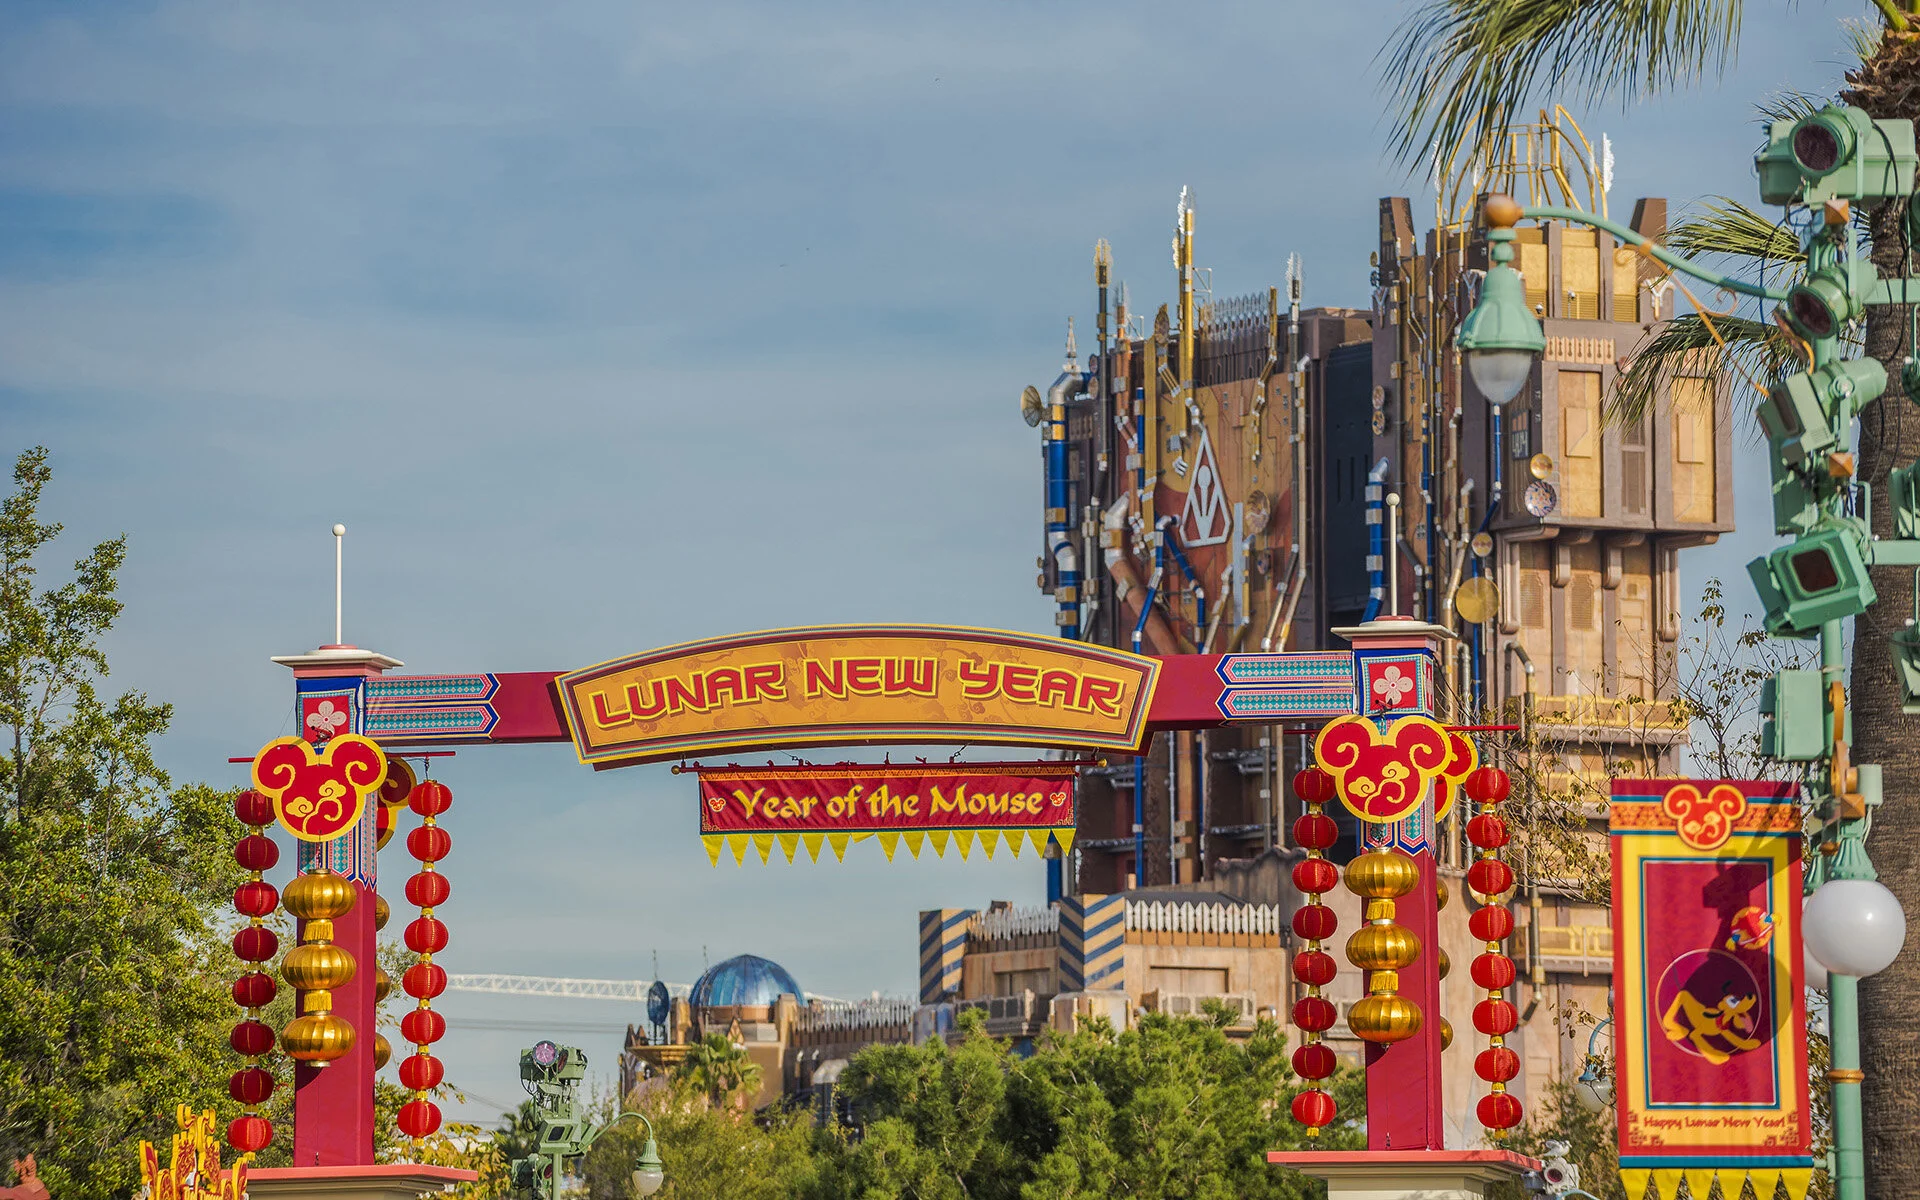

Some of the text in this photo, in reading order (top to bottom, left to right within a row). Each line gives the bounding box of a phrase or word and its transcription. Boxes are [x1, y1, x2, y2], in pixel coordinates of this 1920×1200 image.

[589, 656, 1125, 729] LUNAR NEW YEAR
[733, 782, 1044, 820] Year of the Mouse
[1643, 1115, 1682, 1129] Happy
[1685, 1115, 1720, 1128] Lunar
[1720, 1115, 1751, 1128] New
